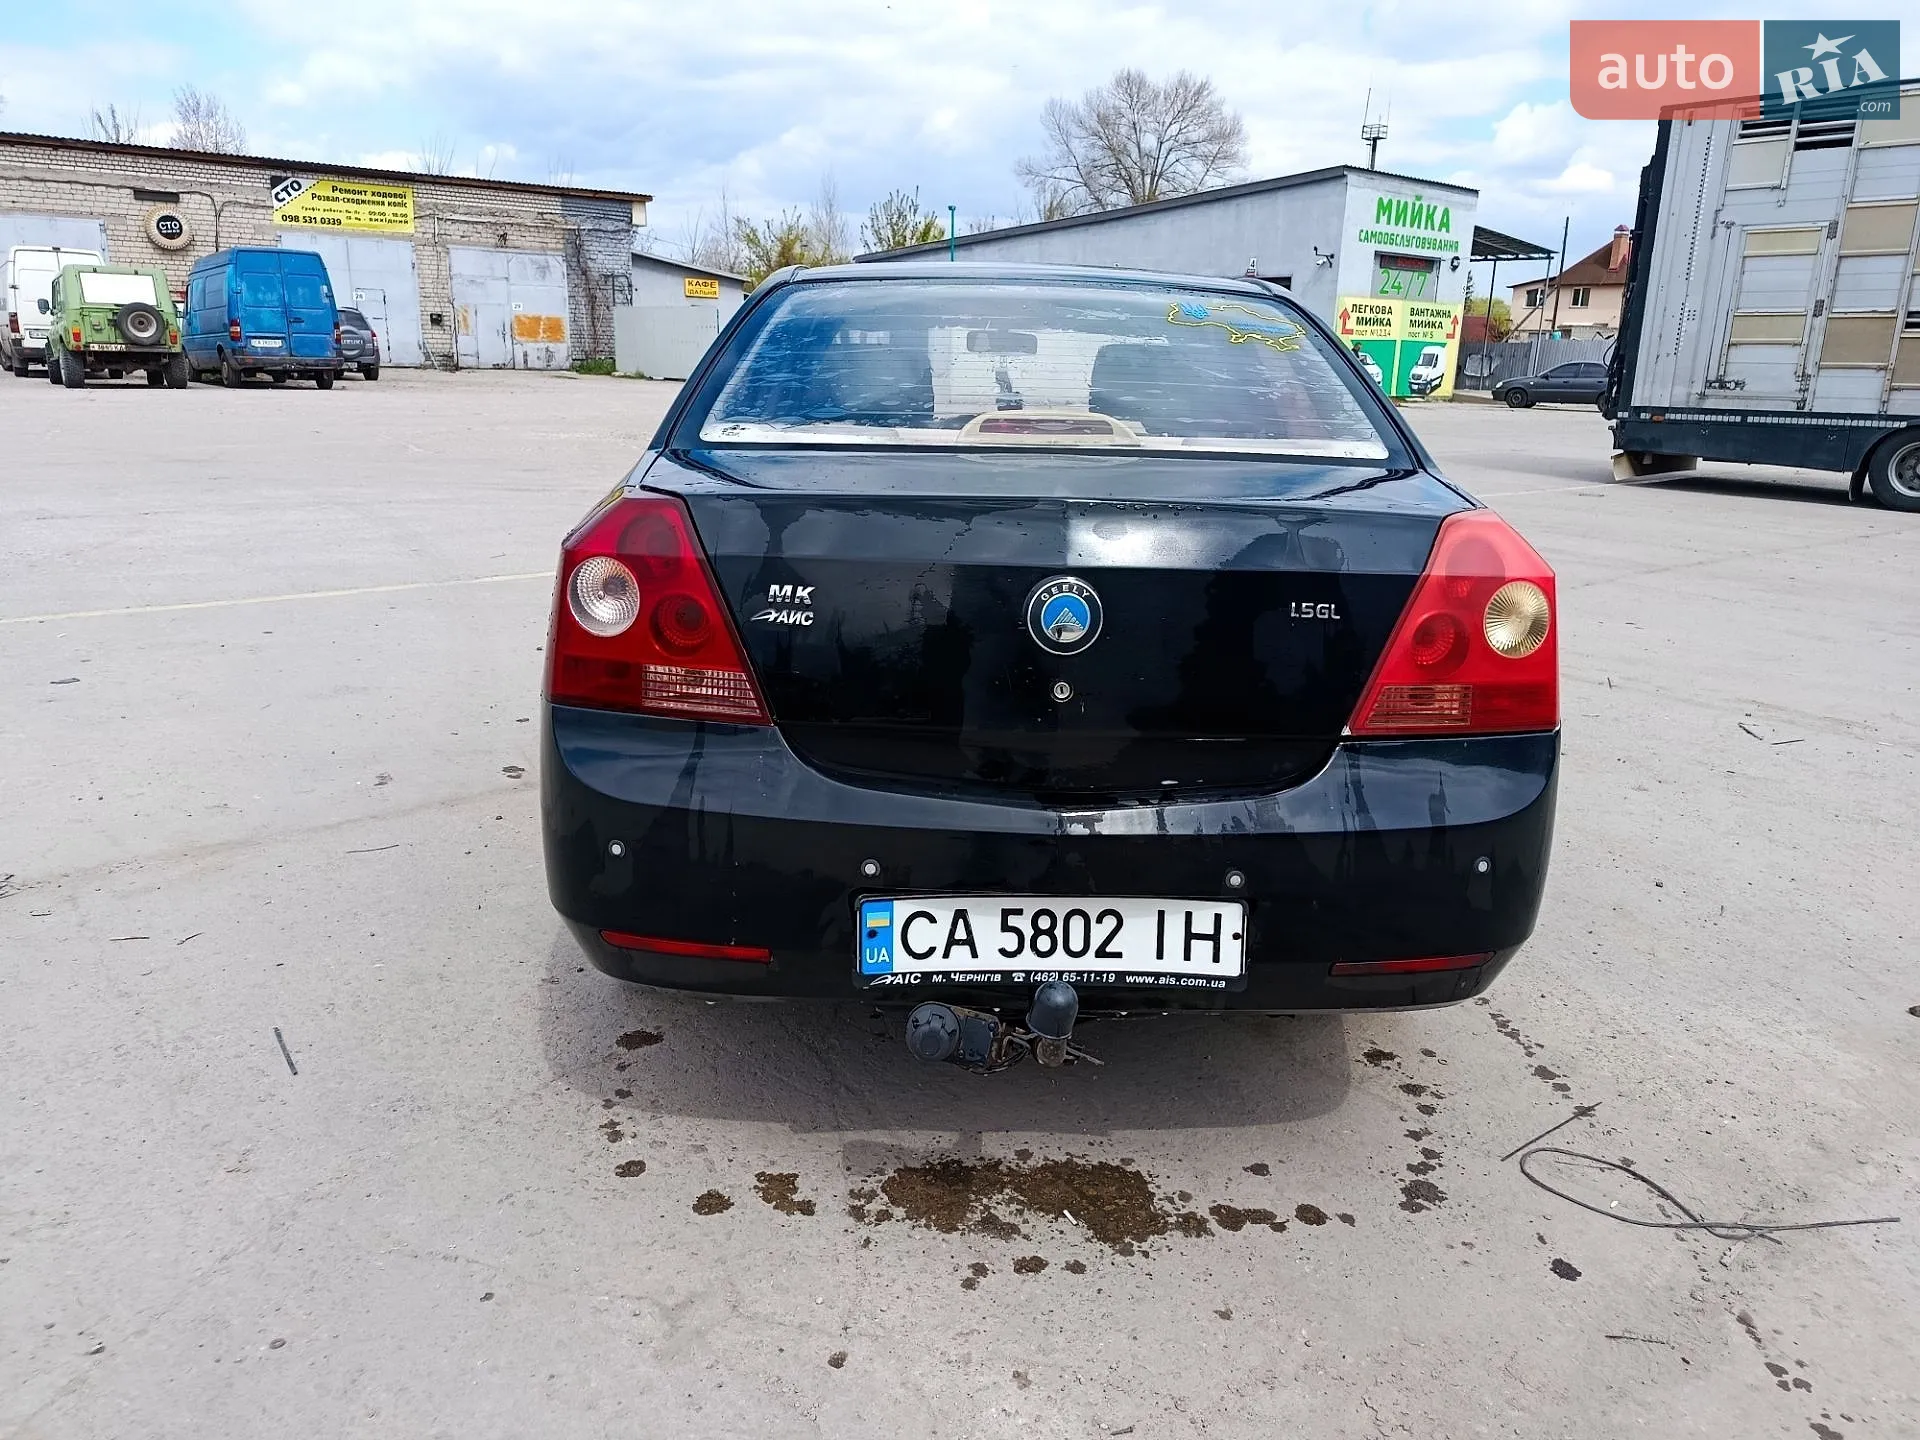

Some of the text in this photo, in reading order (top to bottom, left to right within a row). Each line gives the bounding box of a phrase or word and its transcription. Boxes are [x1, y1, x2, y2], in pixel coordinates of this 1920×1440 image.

[274, 179, 303, 203] СТО
[331, 185, 407, 199] Ремонт ходової
[311, 192, 408, 208] Розвал-сходження коліс
[281, 214, 300, 222] 098
[302, 215, 318, 224] 531
[320, 217, 342, 226] 0339
[1375, 194, 1450, 234] МИЙКА
[159, 221, 180, 230] СТО
[1358, 229, 1459, 253] САМООБСЛУГОВУВАННЯ
[687, 280, 717, 289] КАФЕ
[1379, 269, 1428, 299] 24/7
[1351, 303, 1393, 316] ЛЕГКОВА
[1409, 307, 1452, 319] ВАНТАЖНА
[1356, 315, 1392, 328] МИЙКА
[1409, 318, 1444, 330] МИЙКА
[768, 584, 816, 605] MK
[1041, 584, 1090, 601] GEELY
[776, 609, 814, 626] АИС
[901, 908, 1222, 964] CA 5802 IH
[866, 947, 890, 964] UA
[1030, 971, 1059, 983] (462)
[1062, 972, 1116, 983] 65-11-19
[1125, 974, 1226, 989] www.ais.com.ua
